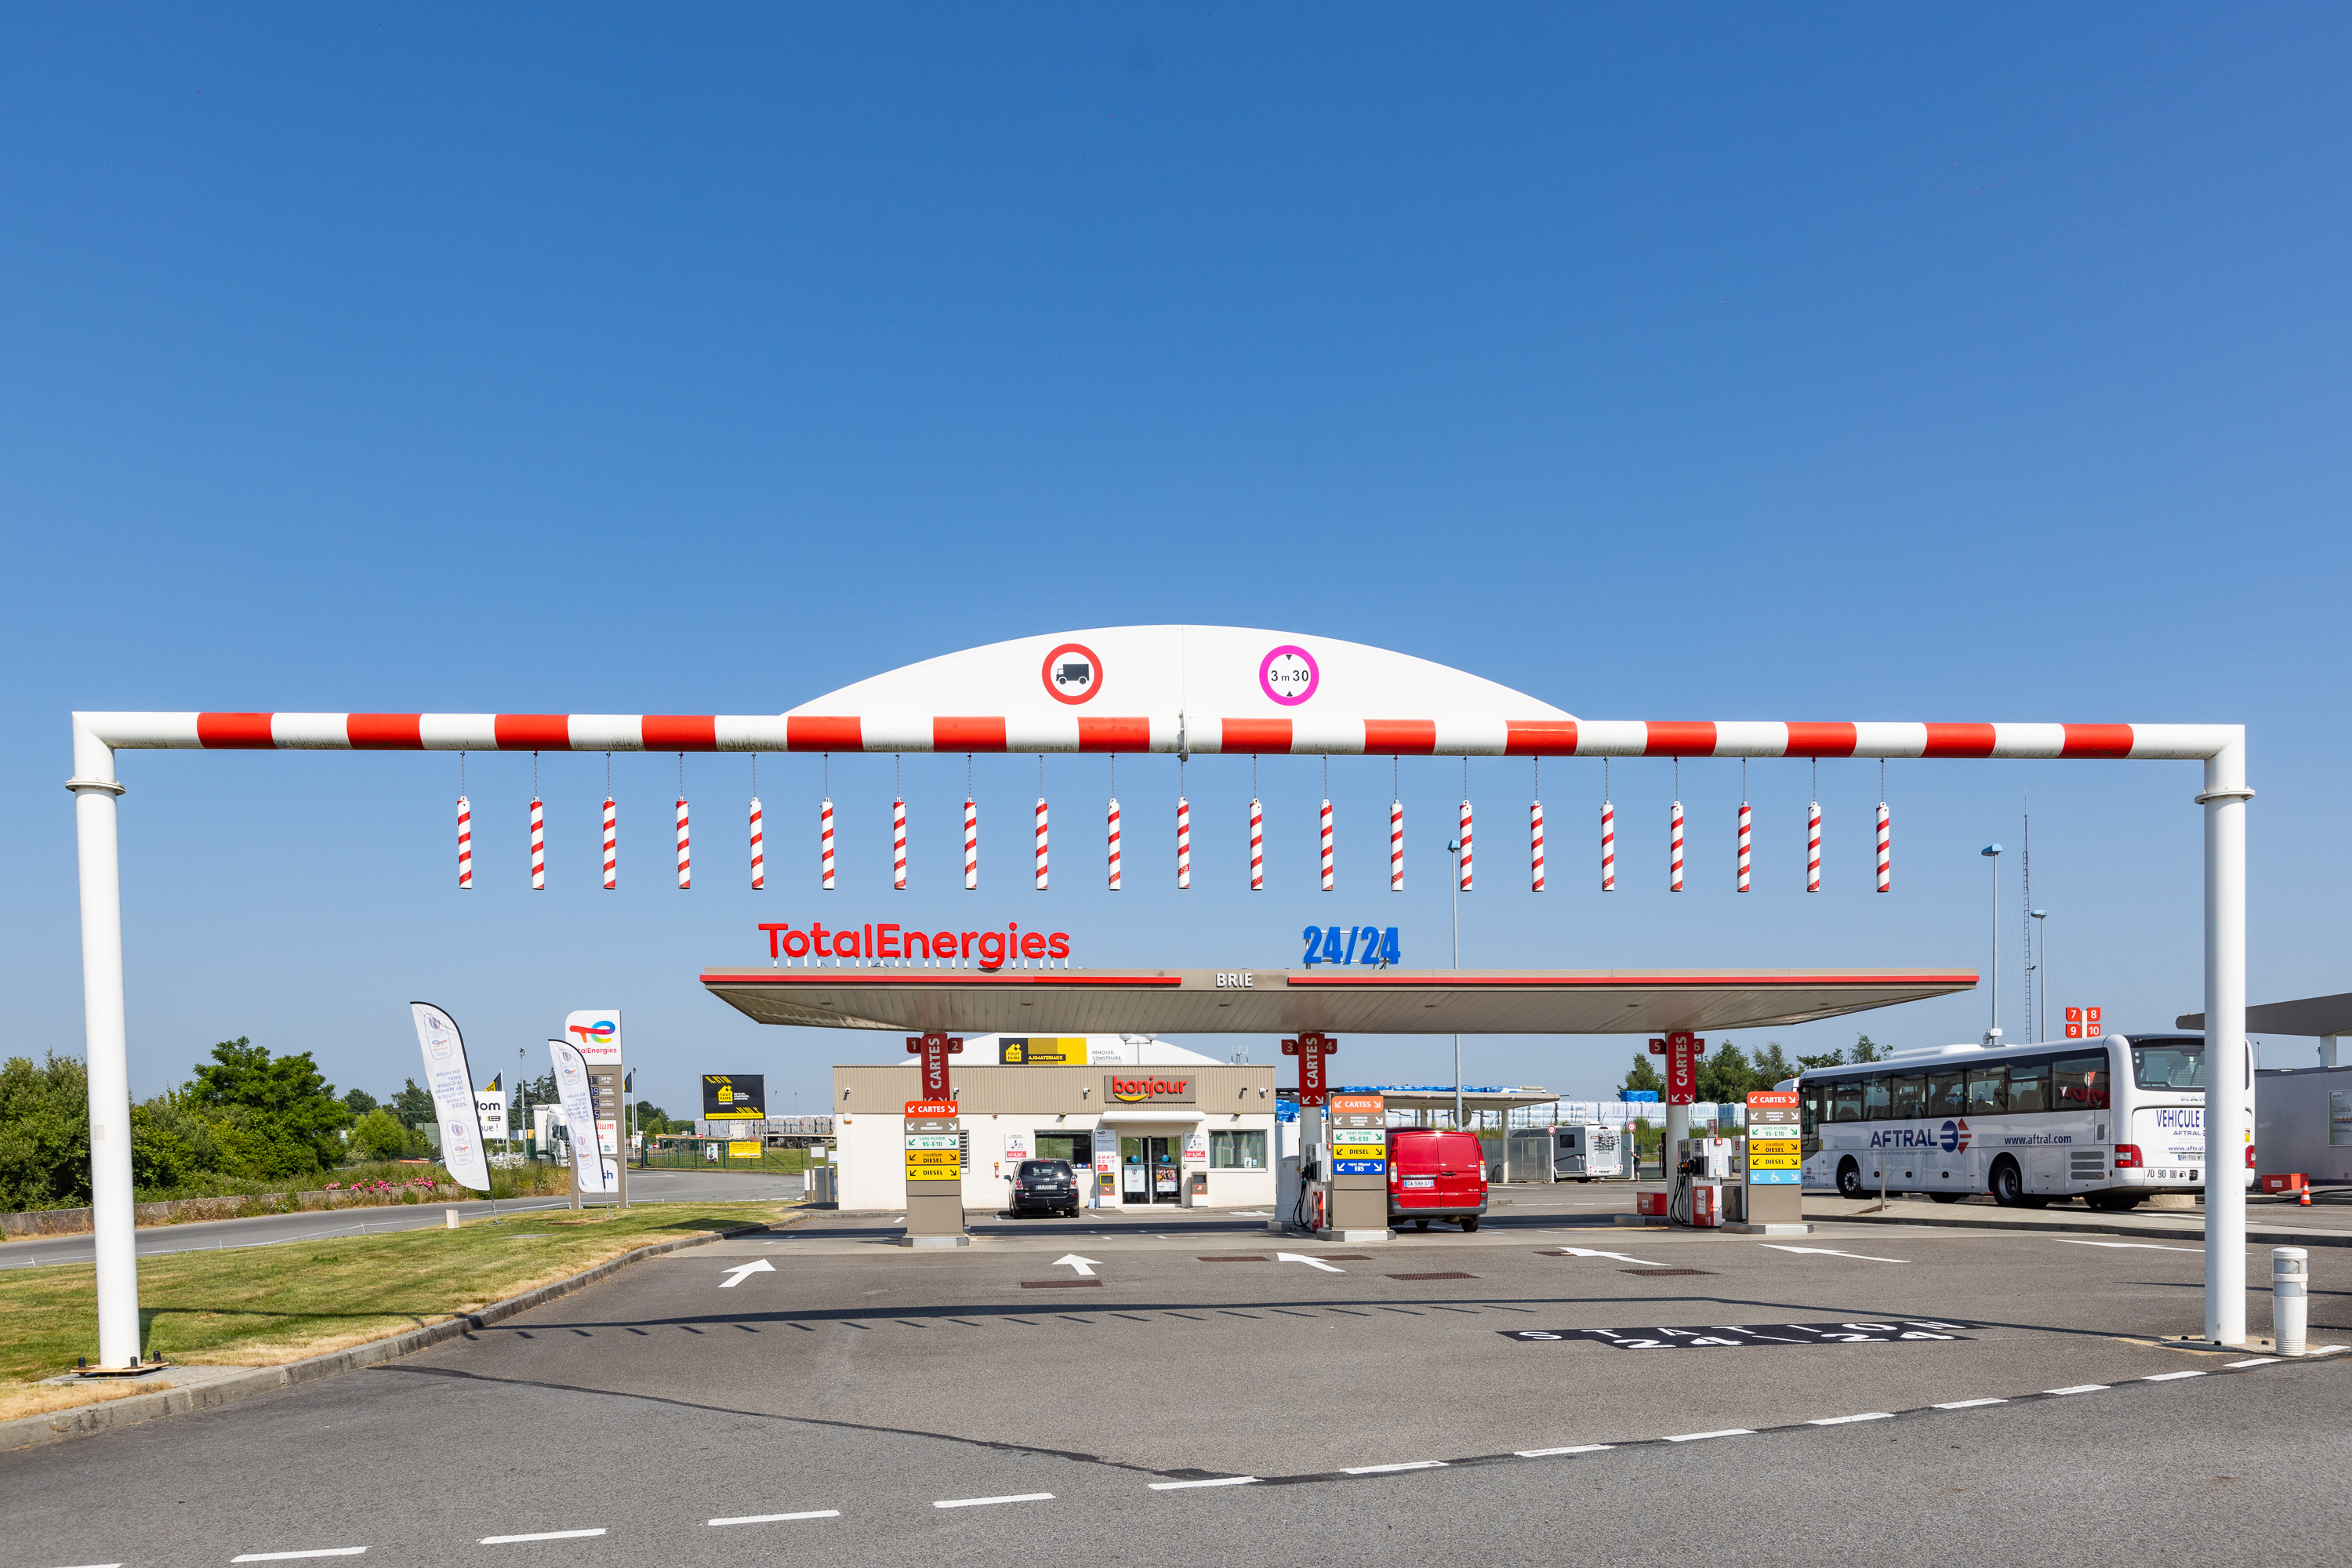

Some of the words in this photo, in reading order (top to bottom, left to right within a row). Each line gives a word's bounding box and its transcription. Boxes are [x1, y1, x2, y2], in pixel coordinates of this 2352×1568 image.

[1270, 670, 1279, 681] 3
[1292, 670, 1309, 681] 30
[758, 922, 1070, 968] TotalEnergies
[1303, 925, 1401, 964] 24/24
[1216, 973, 1254, 988] BRIE
[2071, 1010, 2077, 1018] 7
[2090, 1010, 2097, 1018] 8
[2070, 1026, 2077, 1035] 9
[2089, 1026, 2100, 1035] 10
[911, 1040, 916, 1050] 1
[952, 1040, 959, 1051] 2
[1287, 1042, 1293, 1052] 3
[1326, 1041, 1334, 1051] 4
[1654, 1041, 1661, 1051] 5
[1693, 1041, 1700, 1051] 6
[928, 1038, 942, 1089] CARTES
[1306, 1037, 1319, 1088] CARTES
[1675, 1036, 1688, 1087] CARTES
[1113, 1076, 1188, 1097] bonjour
[2156, 1109, 2200, 1127] VEHICULE
[1870, 1128, 1938, 1148] AFTRAL
[2004, 1133, 2072, 1145] www.aftral.com
[2147, 1169, 2154, 1178] 70
[2158, 1169, 2166, 1178] 90
[1519, 1320, 1966, 1340] STATION
[1624, 1331, 1955, 1349] 24/24
